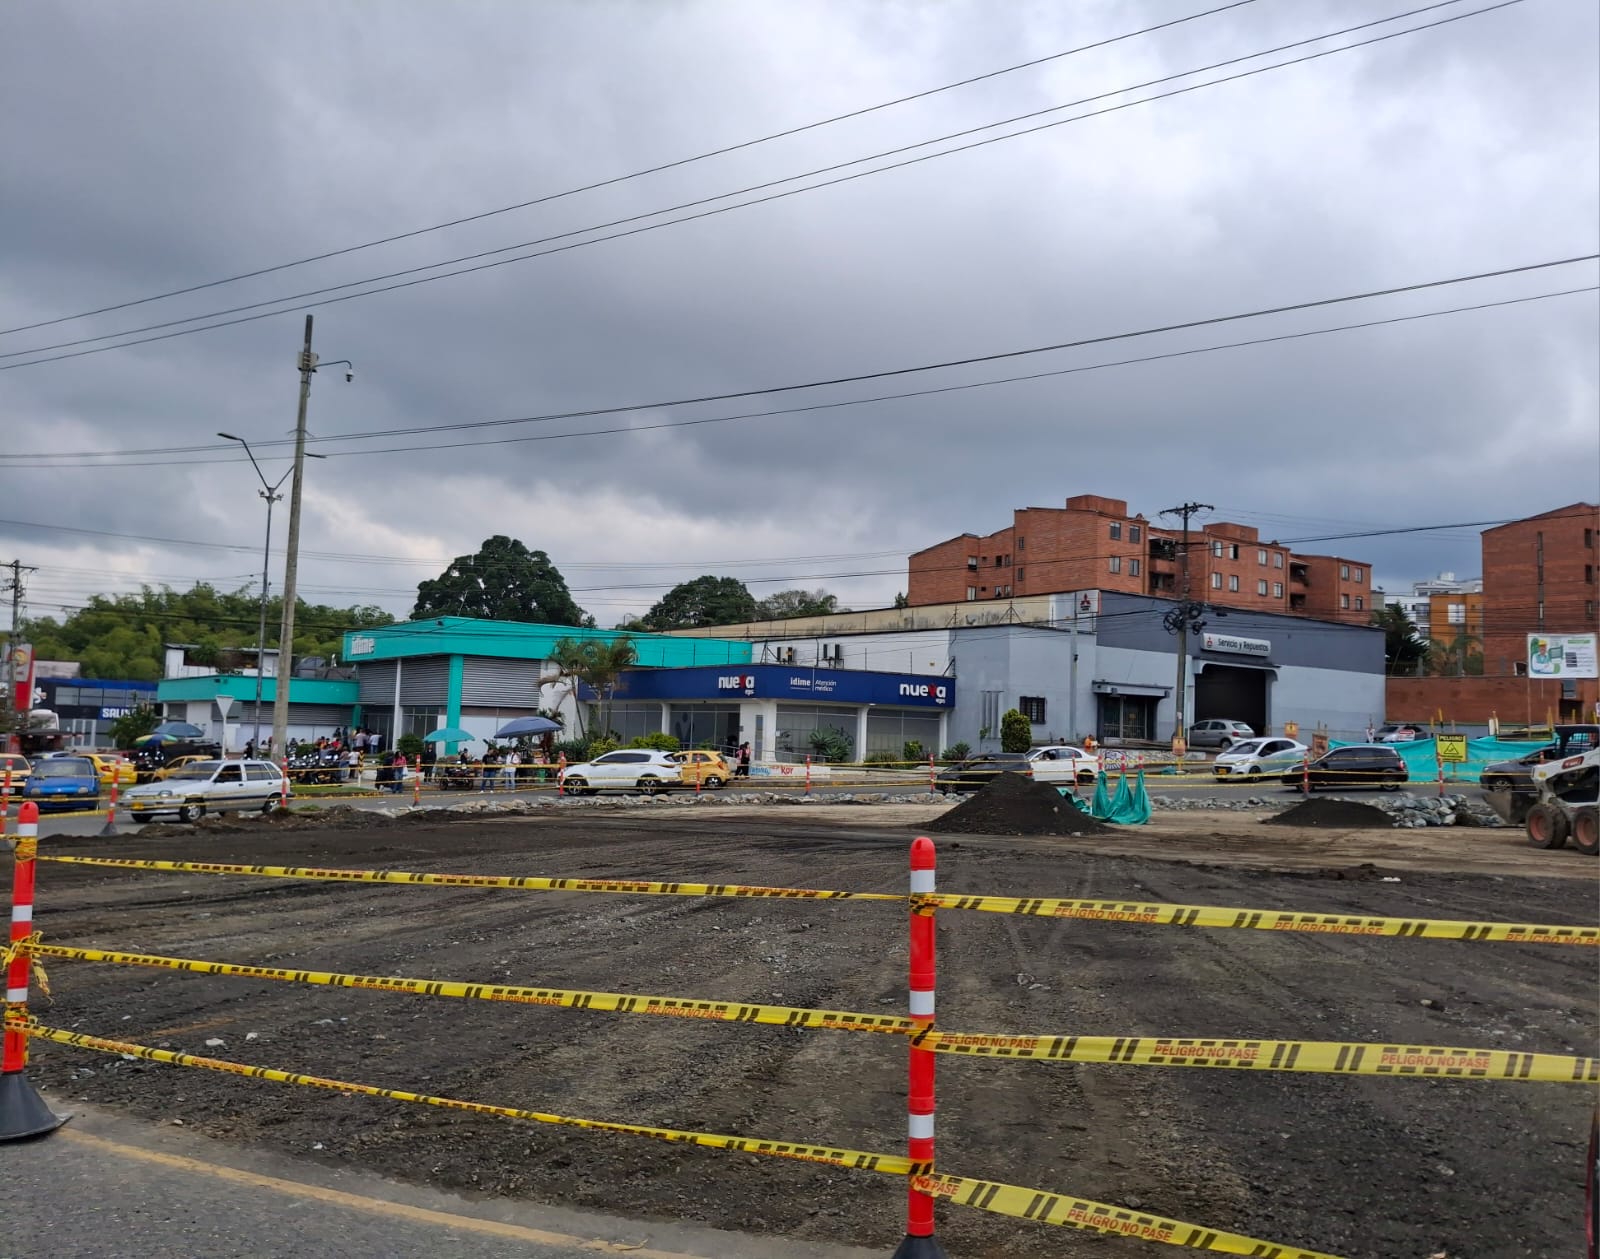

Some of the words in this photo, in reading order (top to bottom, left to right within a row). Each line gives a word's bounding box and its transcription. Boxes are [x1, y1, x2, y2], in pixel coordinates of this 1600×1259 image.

[1218, 638, 1238, 649] Servicio
[1054, 907, 1105, 919] PELIGRO
[1107, 911, 1124, 920] NO
[1127, 912, 1159, 923] PASE
[645, 1004, 685, 1016] PELIGRO
[687, 1008, 701, 1017] NO
[702, 1009, 726, 1020] PASE
[940, 1036, 988, 1046] PELIGRO
[990, 1038, 1006, 1047] NO
[1009, 1039, 1039, 1049] PASE
[1154, 1045, 1206, 1057] PELIGRO
[1207, 1047, 1224, 1058] NO
[1228, 1048, 1259, 1060] PASE
[1381, 1054, 1434, 1066] PELIGRO
[1437, 1056, 1455, 1067] NO
[1458, 1057, 1490, 1069] PASE
[931, 1181, 960, 1195] PASE
[1066, 1208, 1119, 1230] PELIGRO
[1120, 1221, 1140, 1234] NO
[1140, 1226, 1174, 1241] PASE
